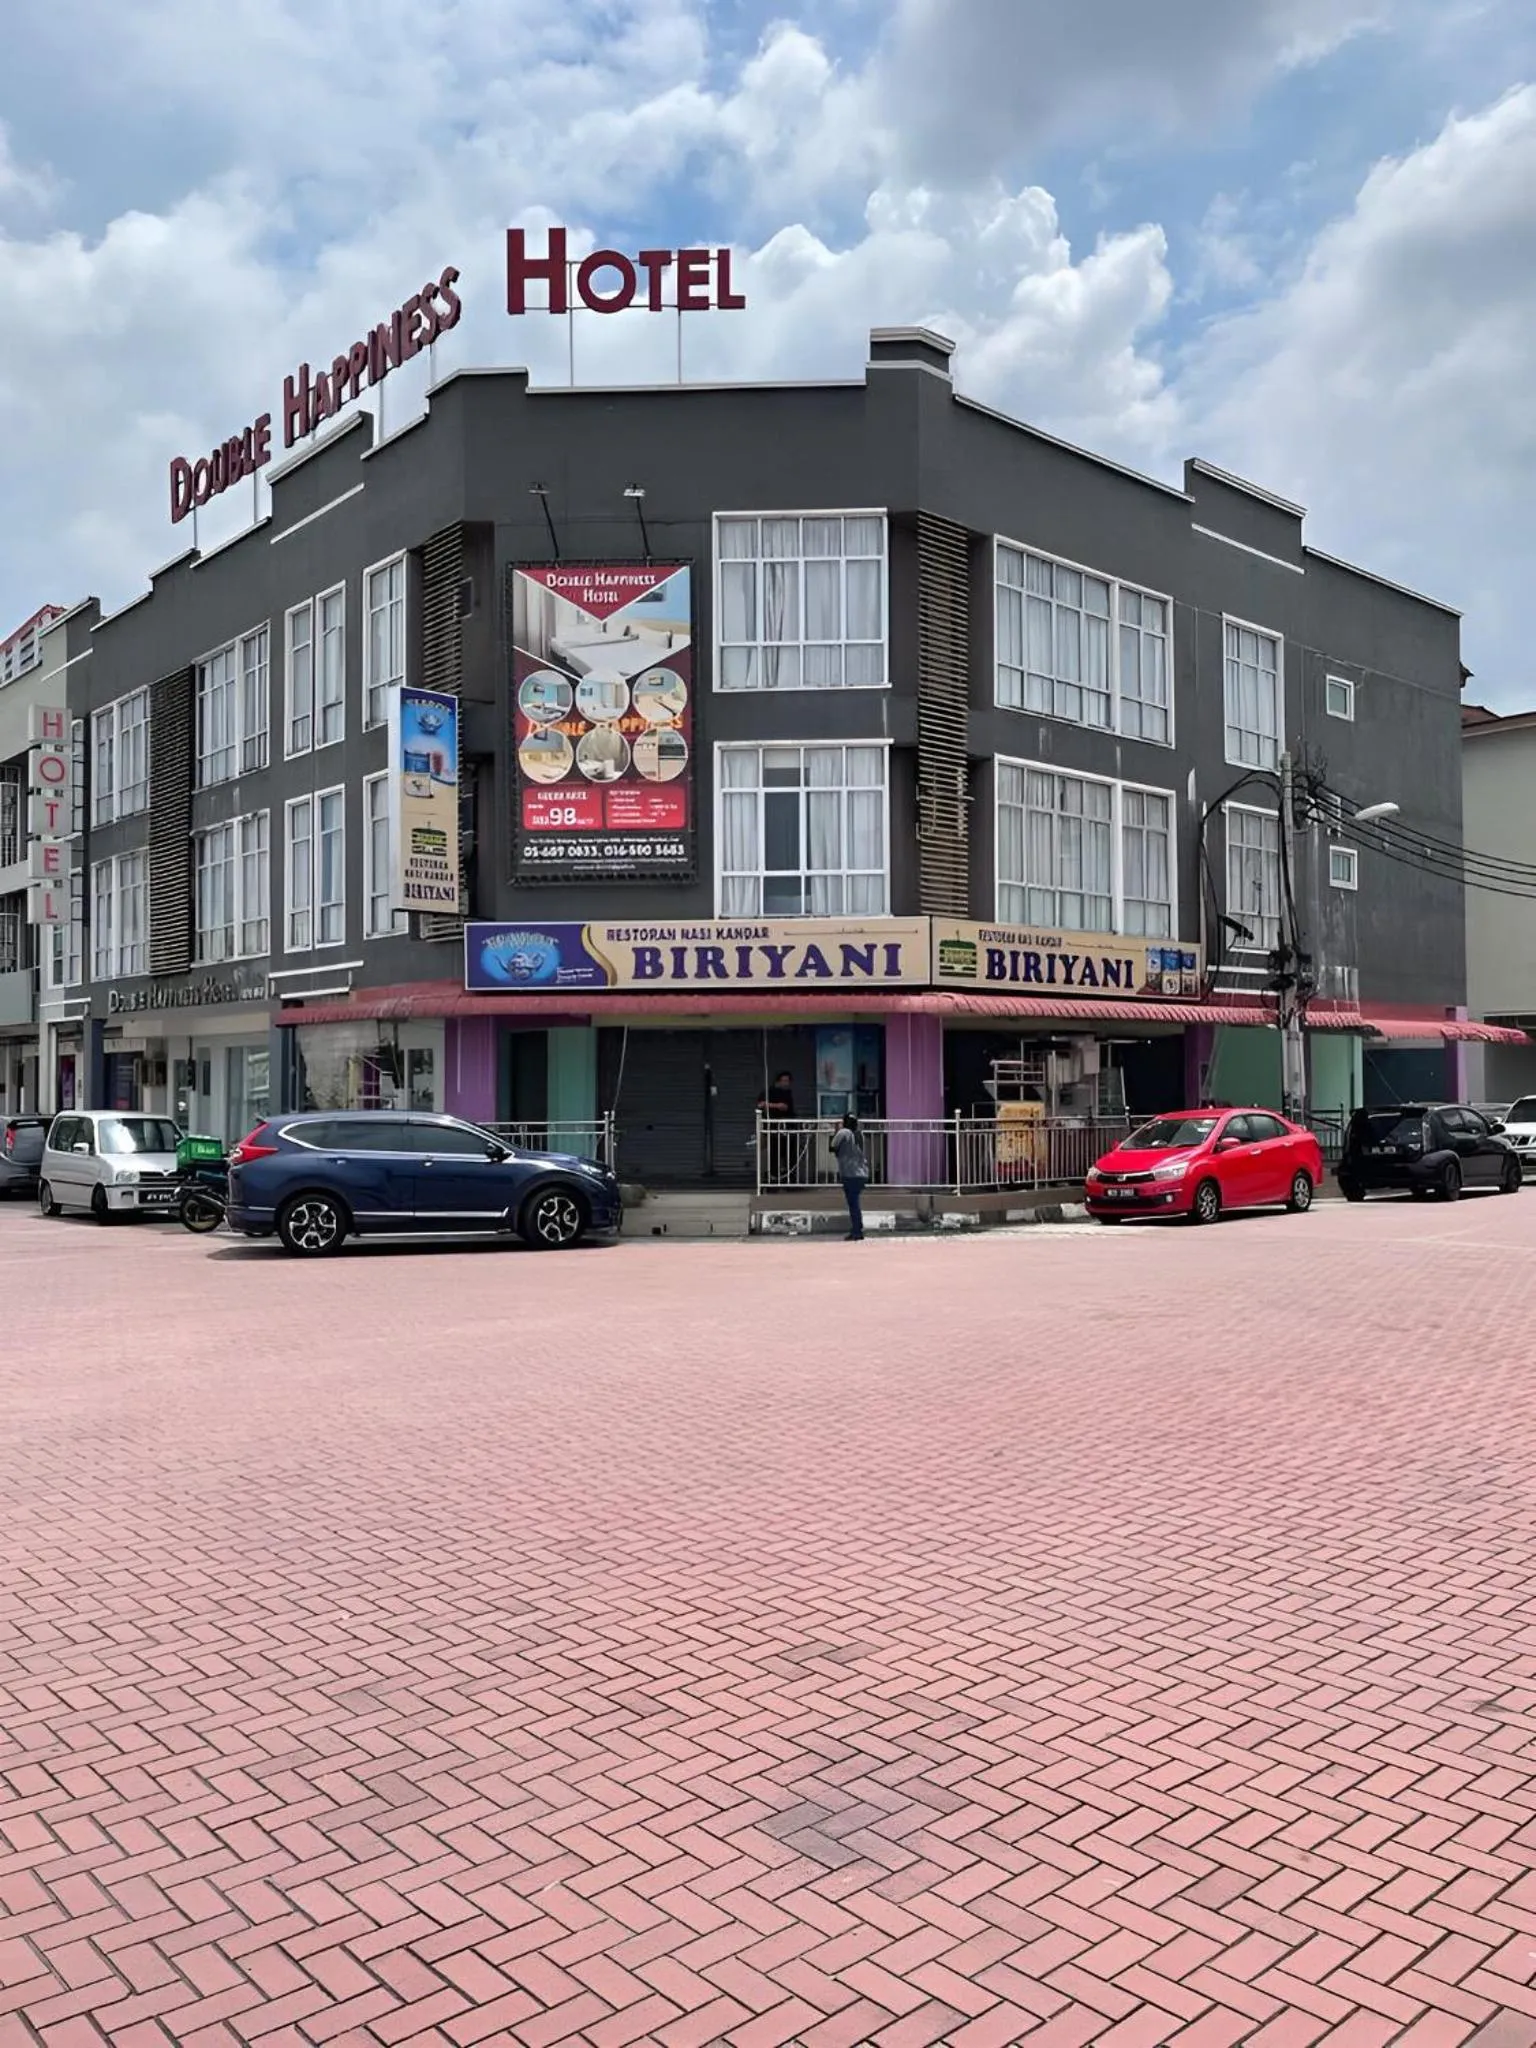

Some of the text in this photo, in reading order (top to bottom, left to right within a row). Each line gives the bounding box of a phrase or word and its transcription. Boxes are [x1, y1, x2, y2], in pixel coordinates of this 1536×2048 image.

[507, 227, 747, 315] HOTEL
[170, 266, 462, 524] DOUBLE HAPPINESS
[40, 711, 65, 920] HOTEL
[549, 807, 577, 826] 98
[606, 927, 677, 941] RESTORAN
[681, 927, 712, 940] NASI
[715, 926, 770, 940] KANDAR
[631, 943, 902, 980] BIRIYANI
[985, 948, 1134, 989] BIRIYANI
